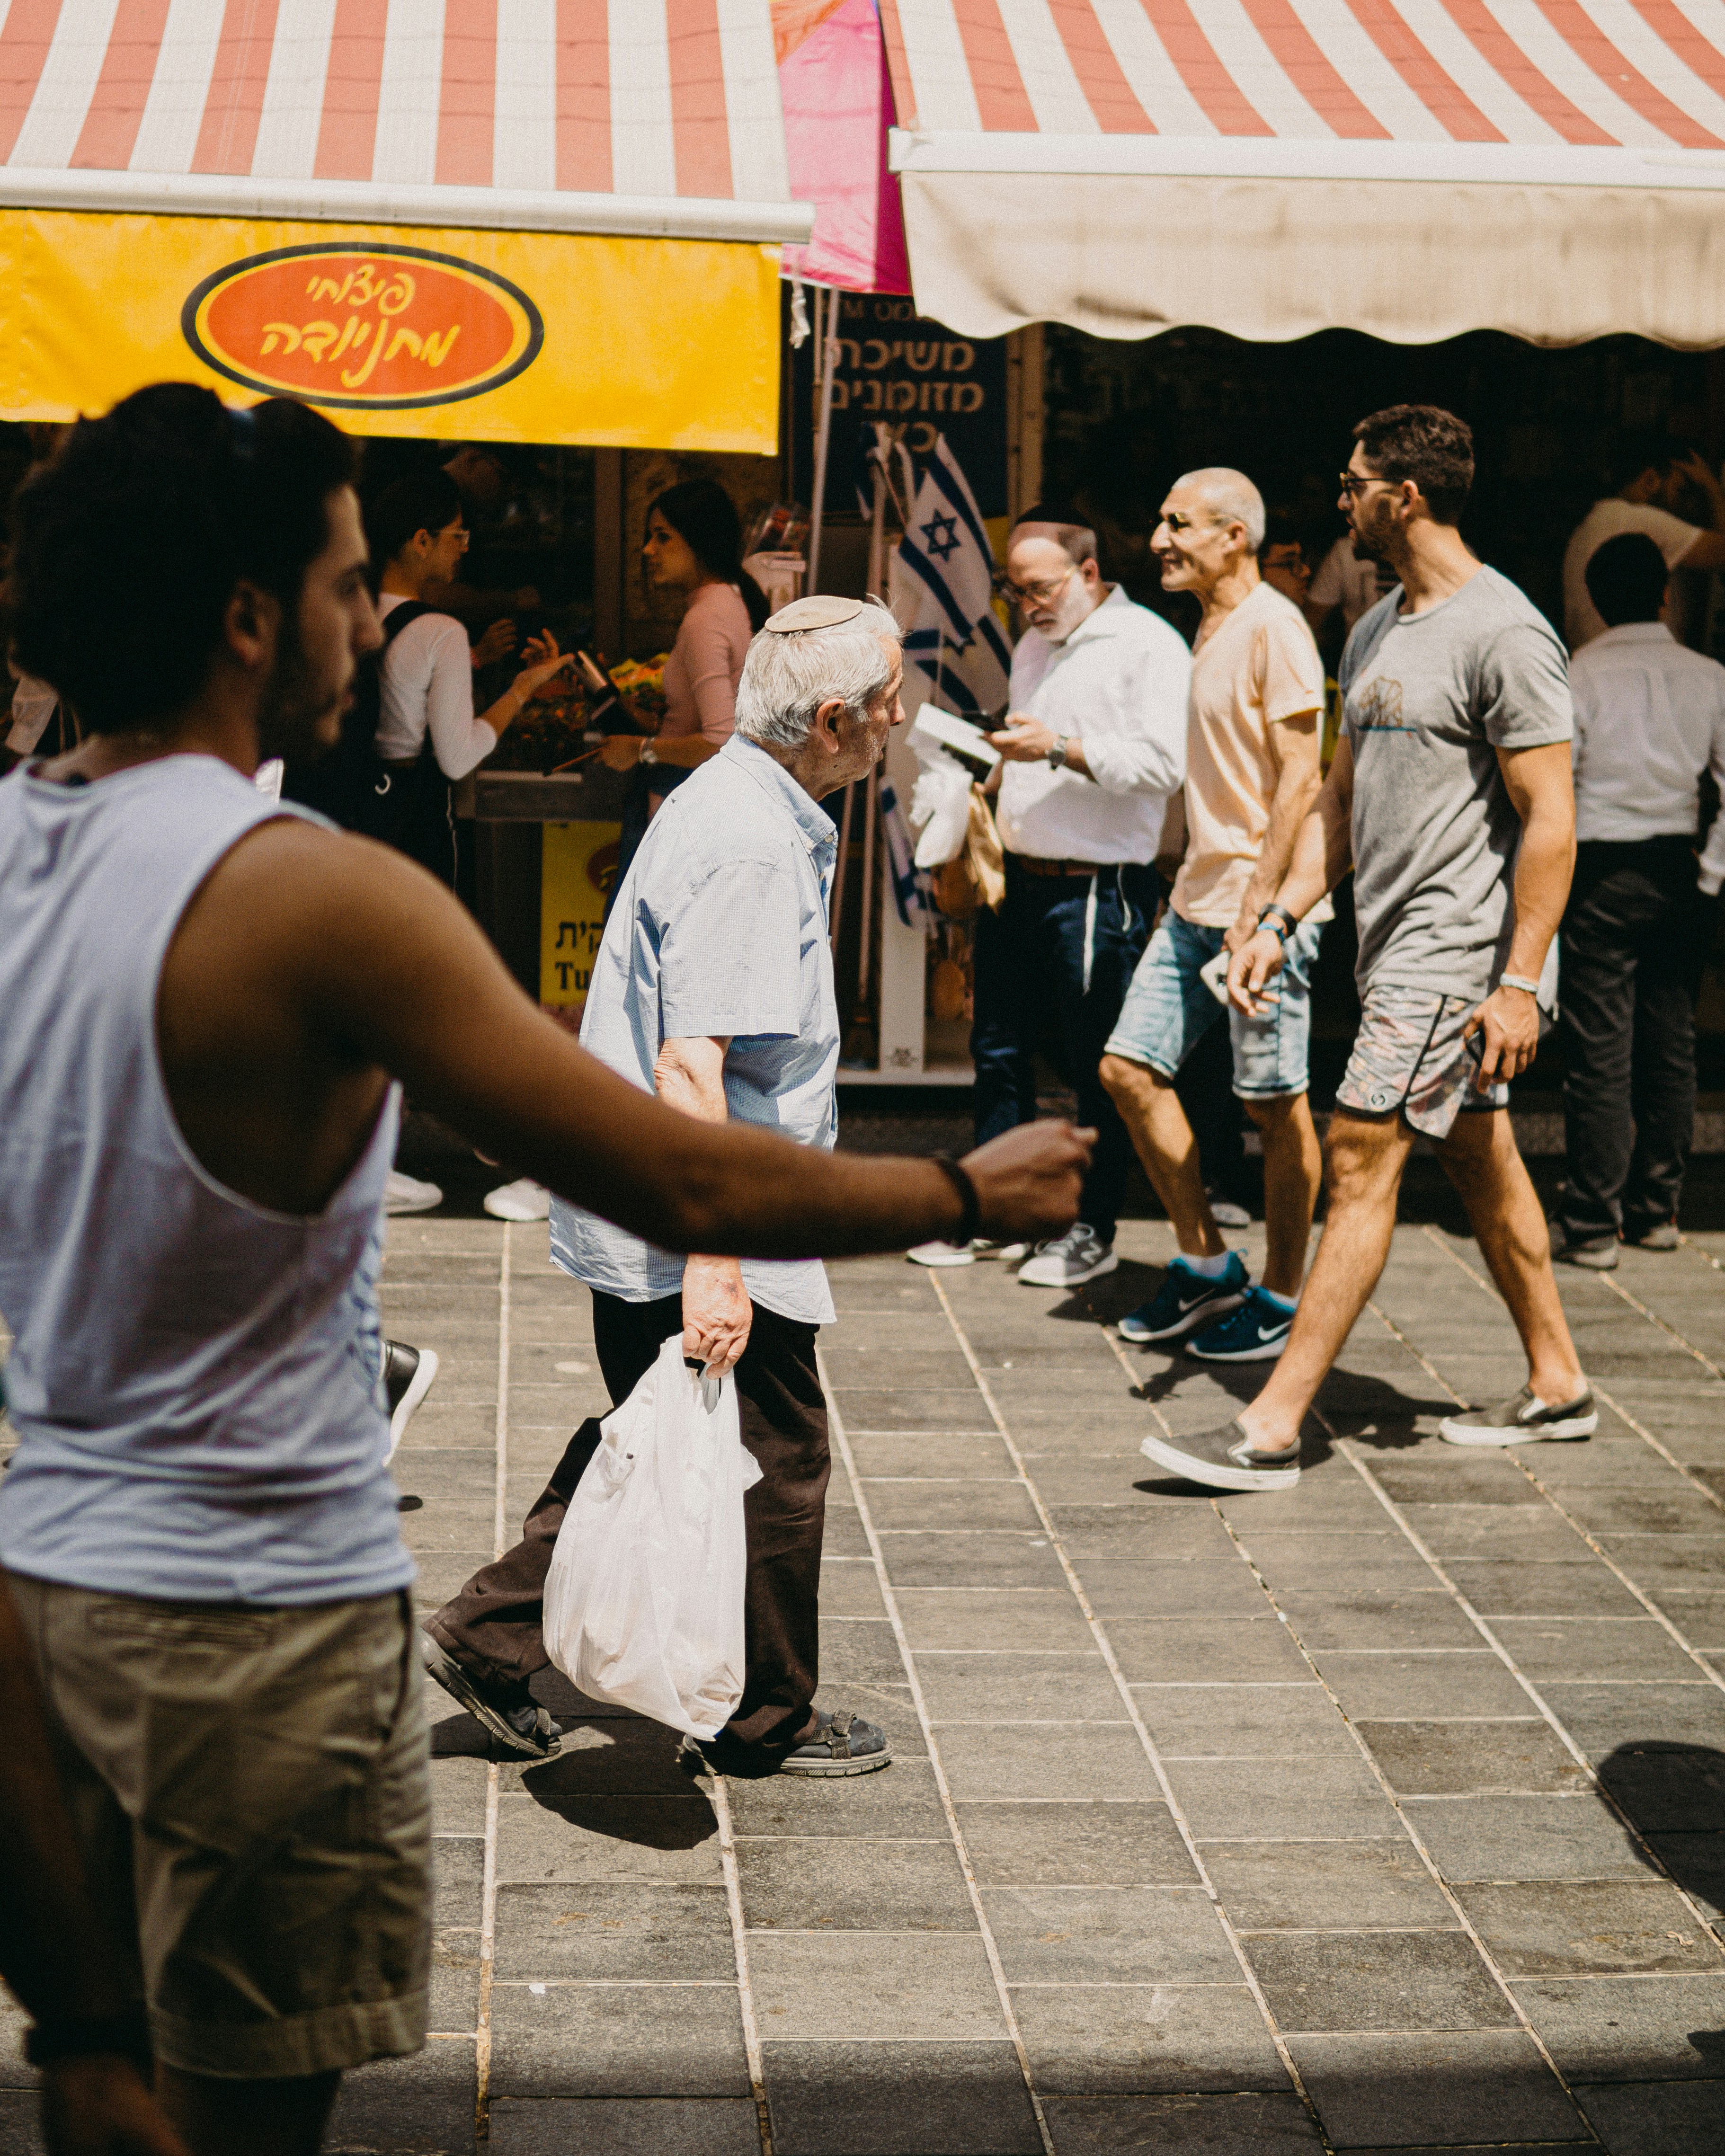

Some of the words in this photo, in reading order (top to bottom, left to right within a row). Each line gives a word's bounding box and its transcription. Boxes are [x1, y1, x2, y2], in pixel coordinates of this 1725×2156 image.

[306, 263, 417, 315] פיצוחי
[830, 380, 985, 413] מזומנים
[555, 922, 604, 953] קית
[555, 962, 590, 990] Tu
